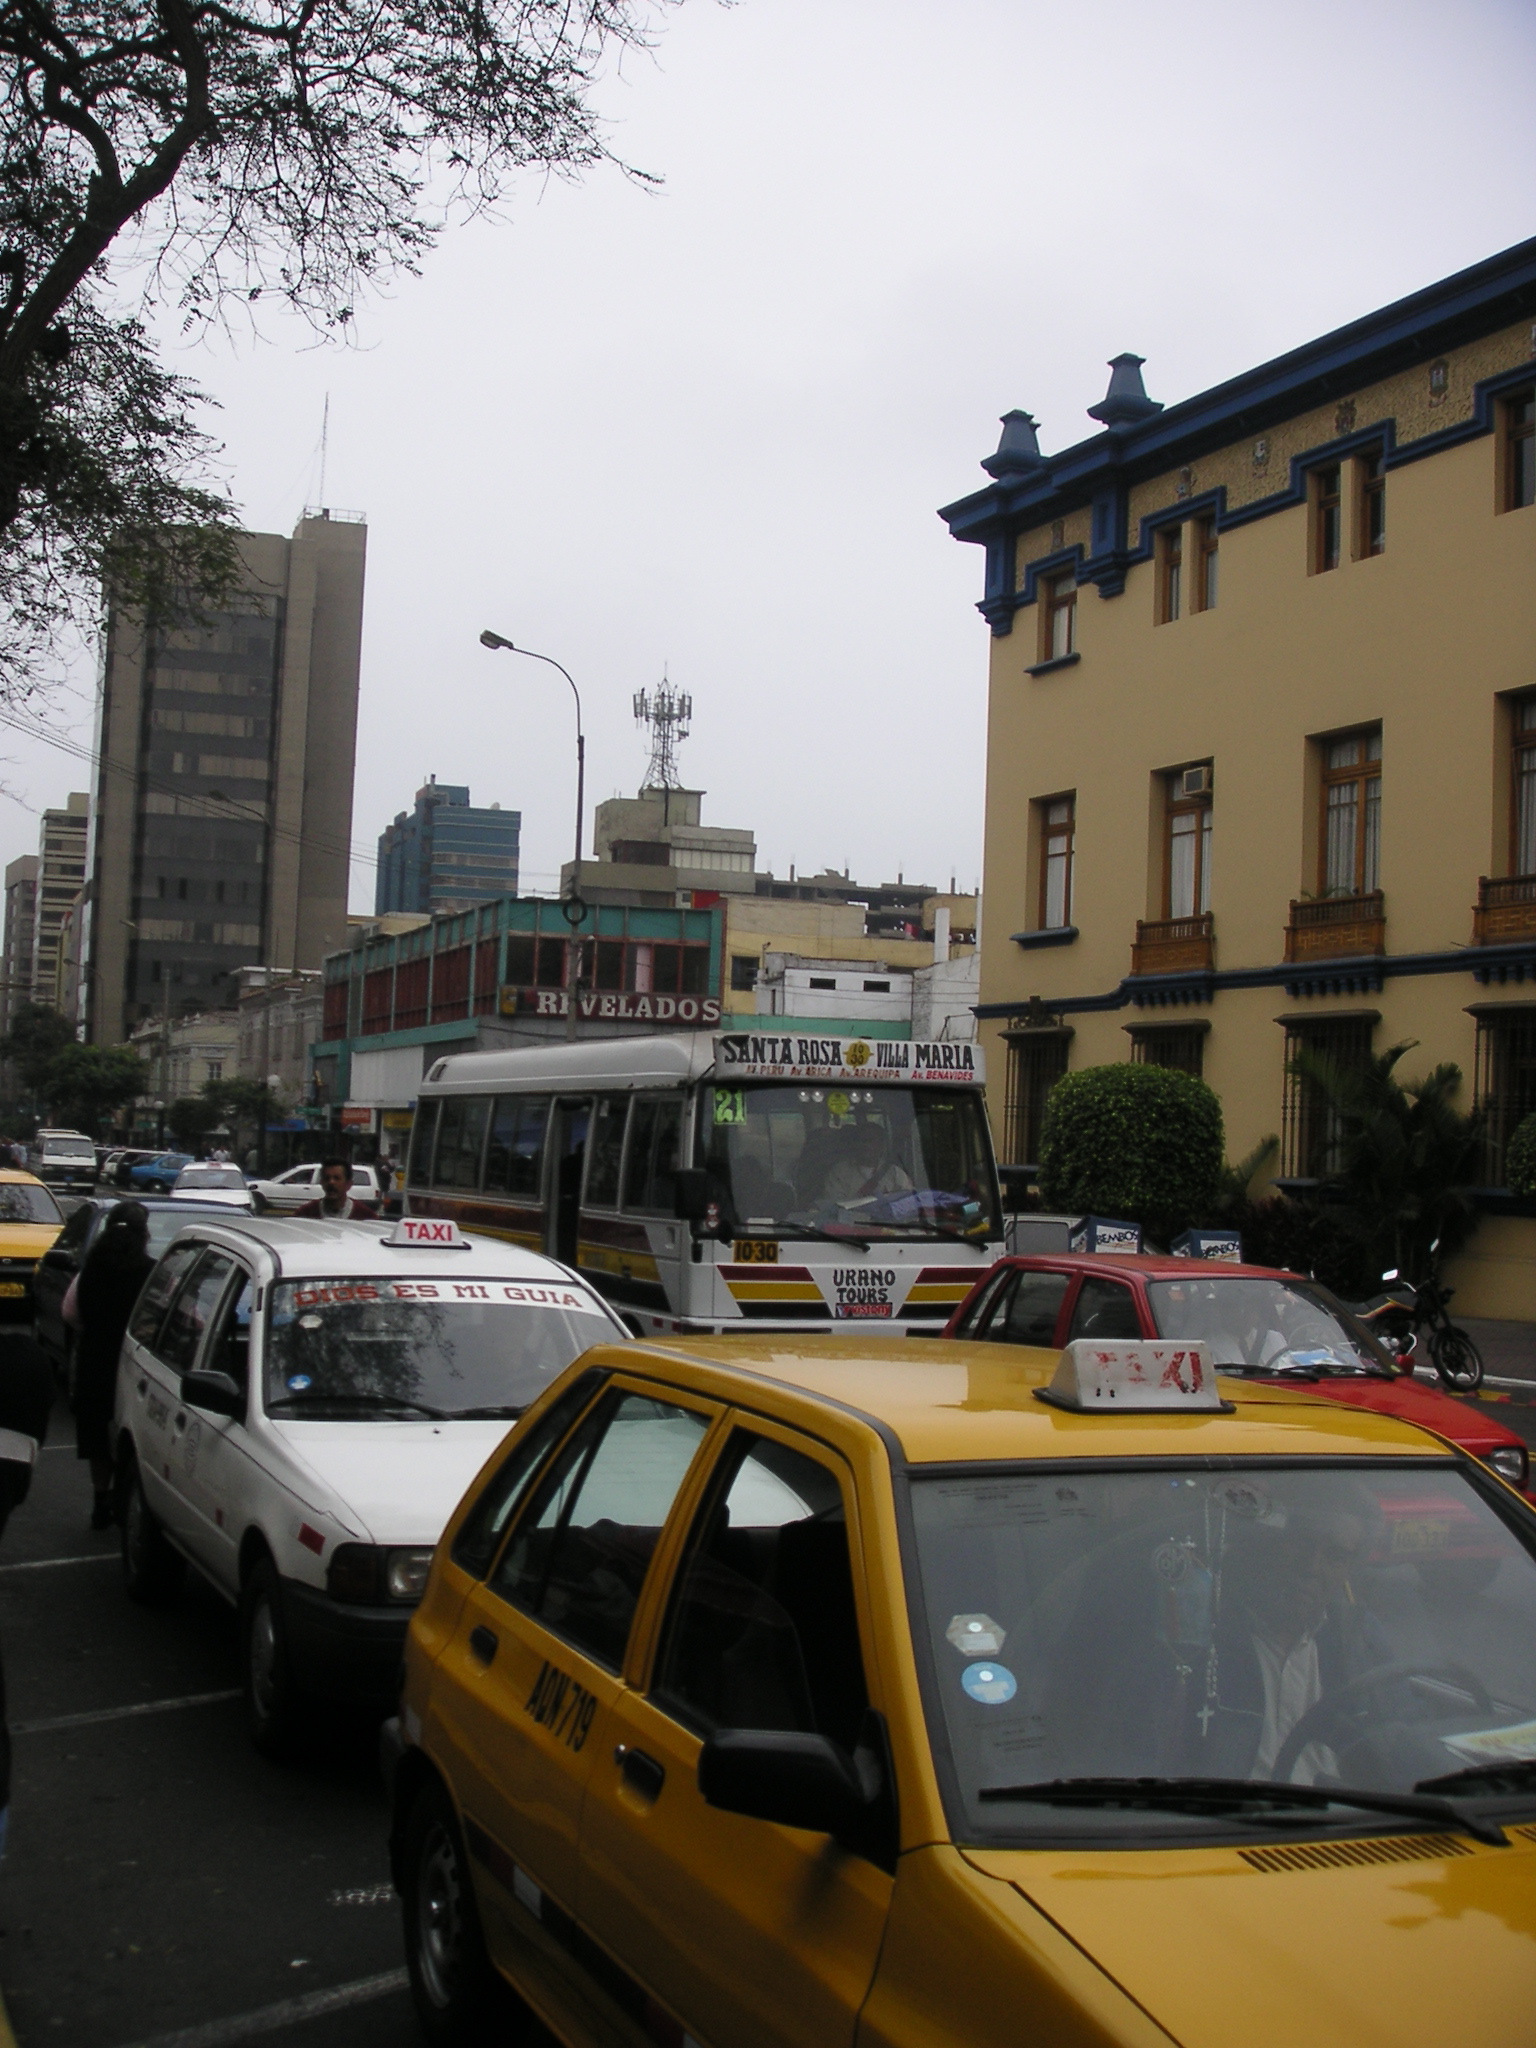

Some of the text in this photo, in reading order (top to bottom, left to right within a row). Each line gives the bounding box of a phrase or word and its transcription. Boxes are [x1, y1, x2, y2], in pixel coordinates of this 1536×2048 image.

[722, 1036, 843, 1065] SANTA ROSA
[877, 1043, 975, 1070] VILLA MARIA
[760, 1065, 785, 1075] PERU
[805, 1067, 832, 1077] ARICA
[854, 1068, 900, 1079] AREQUIPA
[926, 1070, 974, 1081] BENAVIDES
[715, 1089, 745, 1122] 21
[404, 1222, 453, 1242] TAXI
[1097, 1231, 1138, 1245] BEMBOS
[833, 1269, 896, 1286] URANO
[294, 1284, 583, 1308] DIOS ES MI GUIA
[836, 1287, 888, 1303] TOURS
